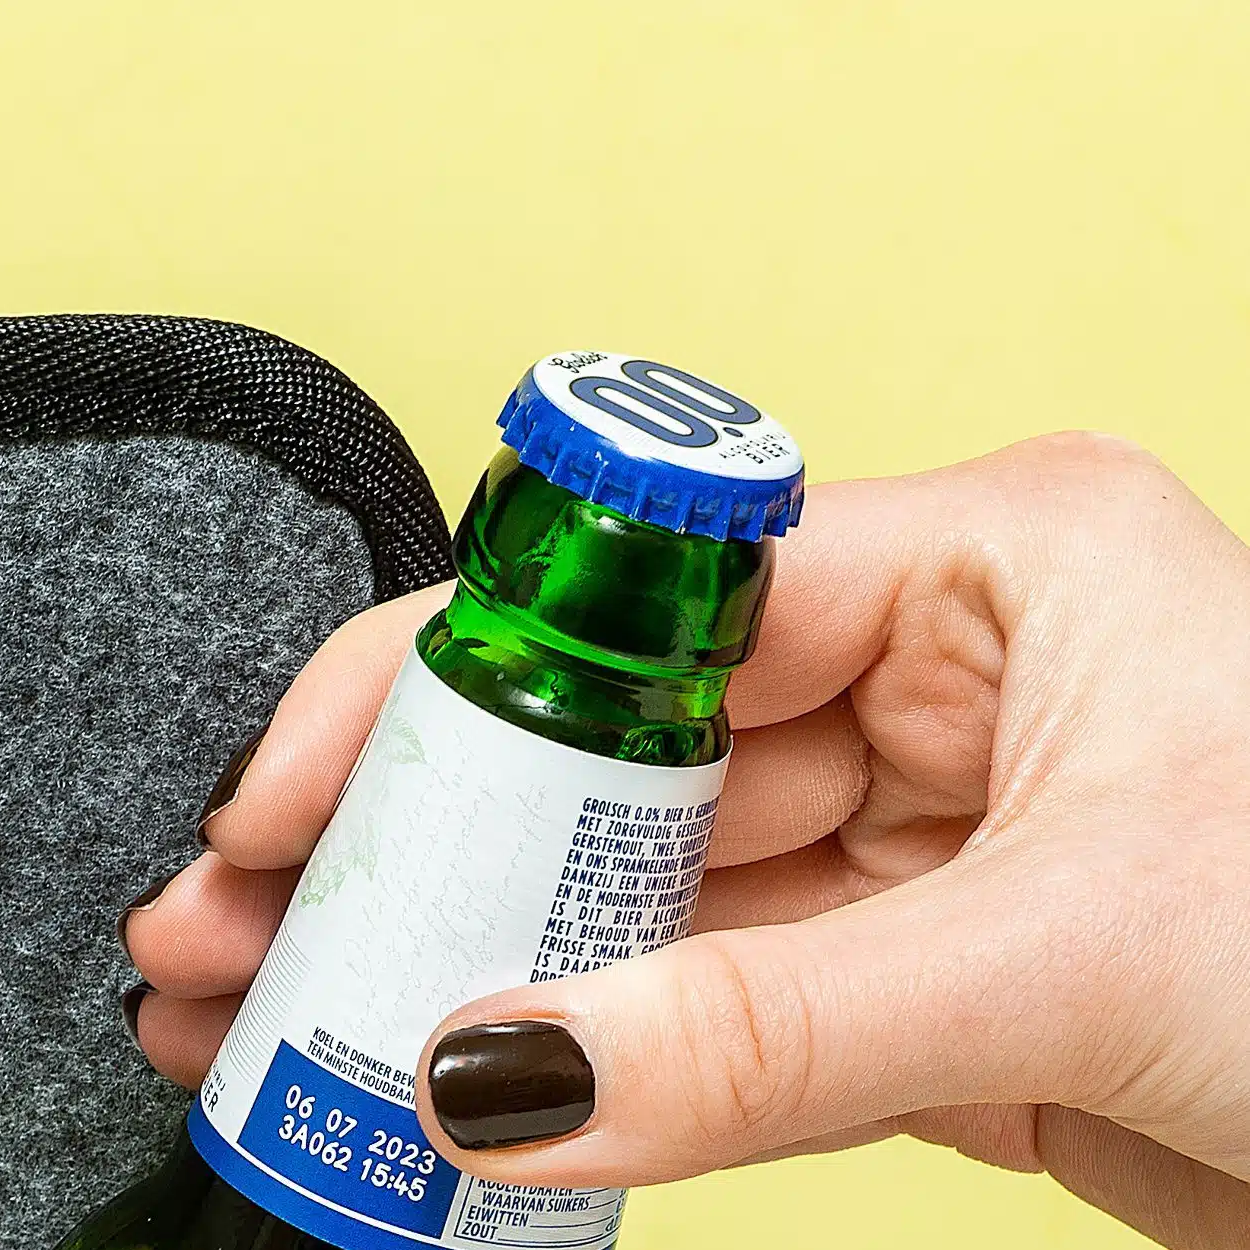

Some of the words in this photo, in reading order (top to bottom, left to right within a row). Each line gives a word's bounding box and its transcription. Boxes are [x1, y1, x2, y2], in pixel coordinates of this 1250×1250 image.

[745, 443, 791, 464] BIER
[582, 797, 631, 819] GROLSCH
[635, 806, 661, 822] 0.0%
[663, 807, 684, 822] BIER
[685, 806, 694, 821] IS
[576, 814, 603, 832] MET
[606, 820, 672, 840] ZORGVULDIG
[572, 832, 646, 859] GERSTEMOUT,
[651, 841, 676, 857] TWEE
[566, 848, 582, 865] EN
[586, 853, 608, 870] ONS
[610, 856, 680, 874] SPRANKELENDE
[561, 865, 614, 889] DANKZIJ
[618, 876, 639, 891] EEN
[644, 875, 677, 891] UNIEKE
[556, 883, 573, 900] EN
[577, 887, 593, 904] DE
[596, 889, 655, 909] MODERNSTE
[551, 900, 565, 916] IS
[578, 905, 603, 923] DIT
[613, 909, 643, 926] BIER
[545, 917, 574, 936] MET
[579, 923, 630, 943] BEHOUD
[636, 927, 656, 943] VAN
[660, 923, 676, 940] EEN
[535, 951, 550, 968] IS
[540, 934, 586, 956] FRISSE
[590, 942, 634, 960] SMAAK.
[307, 1040, 325, 1060] TEN
[323, 1053, 360, 1081] MINSTE
[312, 1026, 335, 1049] KOEL
[335, 1041, 350, 1057] EN
[350, 1049, 392, 1079] DONKER
[285, 1084, 316, 1119] 06
[326, 1108, 358, 1139] 07
[367, 1129, 436, 1175] 2023
[278, 1114, 352, 1172] 3A062
[360, 1158, 428, 1201] 15:45
[482, 1191, 545, 1213] WAARVAN
[546, 1197, 591, 1213] SUIKERS
[467, 1205, 530, 1227] EIWITTEN
[461, 1222, 498, 1240] ZOUT
